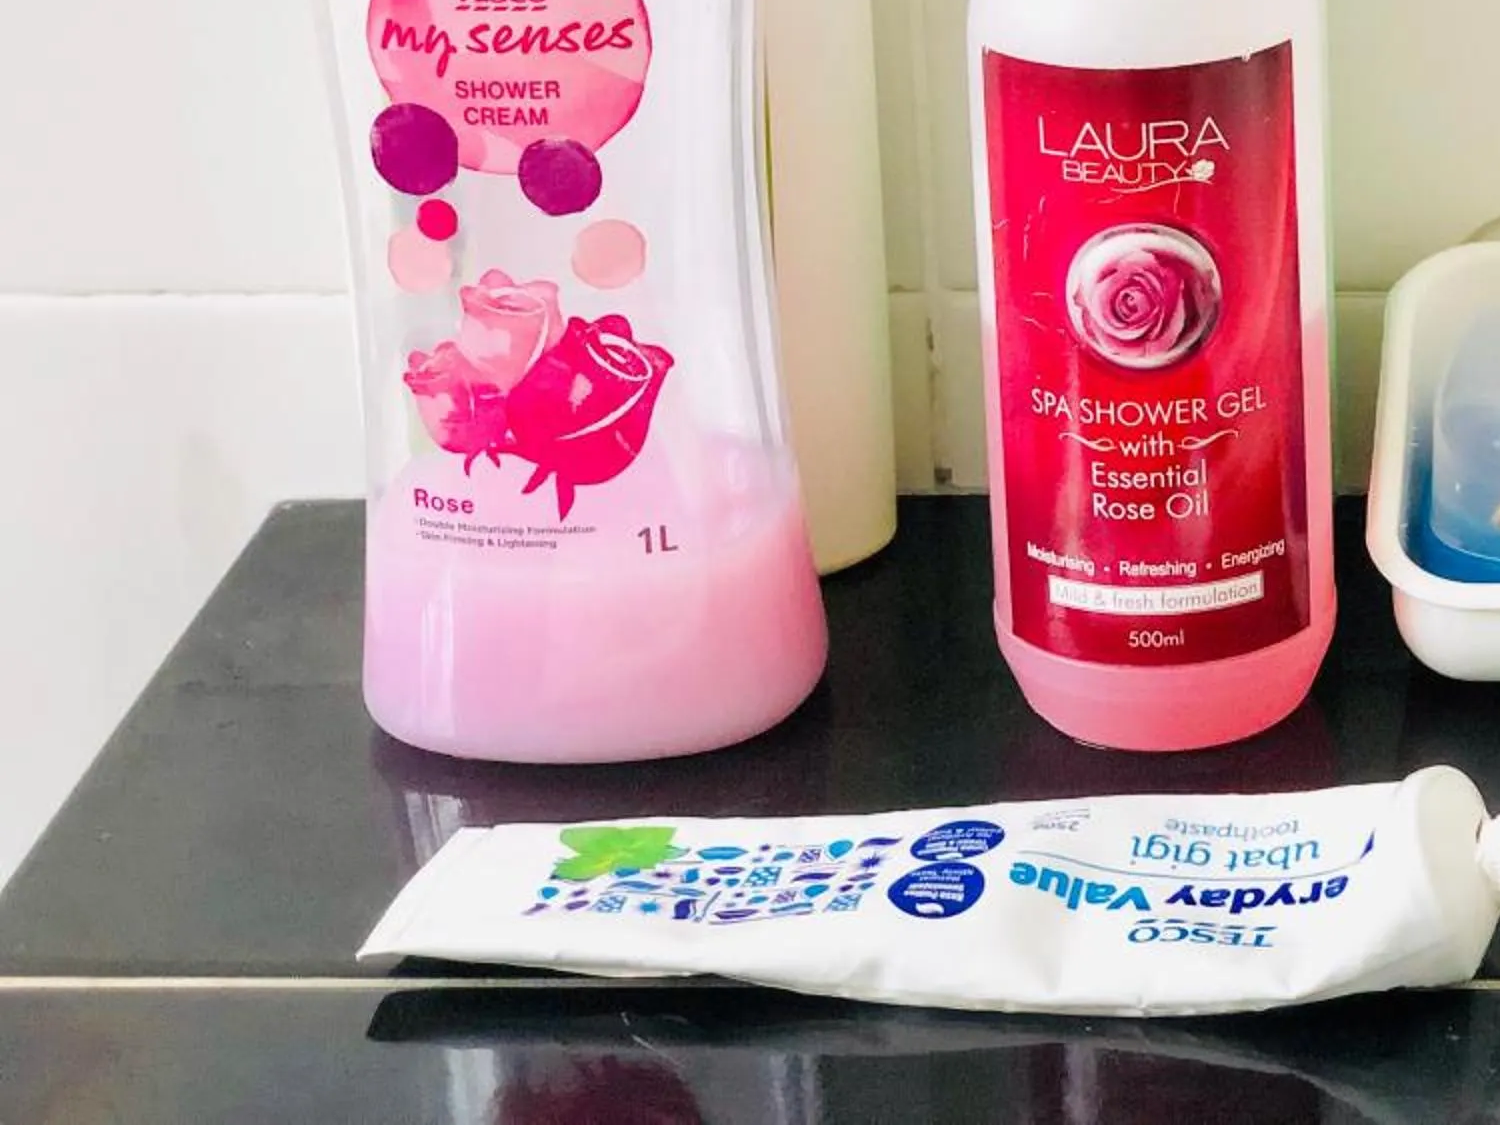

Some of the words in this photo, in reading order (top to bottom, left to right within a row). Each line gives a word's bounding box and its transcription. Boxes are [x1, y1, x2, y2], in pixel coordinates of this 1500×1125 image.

[380, 18, 457, 78] my
[465, 17, 635, 55] senses
[455, 80, 561, 100] SHOWER
[463, 106, 549, 126] CREAM
[1038, 115, 1230, 161] LAURA
[1061, 160, 1188, 184] BEAUTY
[1031, 387, 1072, 422] SPA
[1079, 397, 1209, 426] SHOWER
[1216, 386, 1267, 419] GEL
[1118, 431, 1175, 457] with
[1091, 458, 1208, 490] Essential
[412, 487, 475, 515] Rose
[1091, 492, 1155, 521] Rose
[1166, 490, 1209, 520] Oil
[637, 524, 679, 554] 1L
[1118, 560, 1197, 579] Refreshing
[1221, 537, 1287, 570] Energizing
[1111, 591, 1153, 610] fresh
[1160, 580, 1260, 610] formulation
[1128, 629, 1185, 649] 500ml
[1164, 817, 1300, 839] toothpaste
[1129, 834, 1213, 867] gigi
[1224, 843, 1320, 871] ubat
[1127, 923, 1278, 948] TESCO
